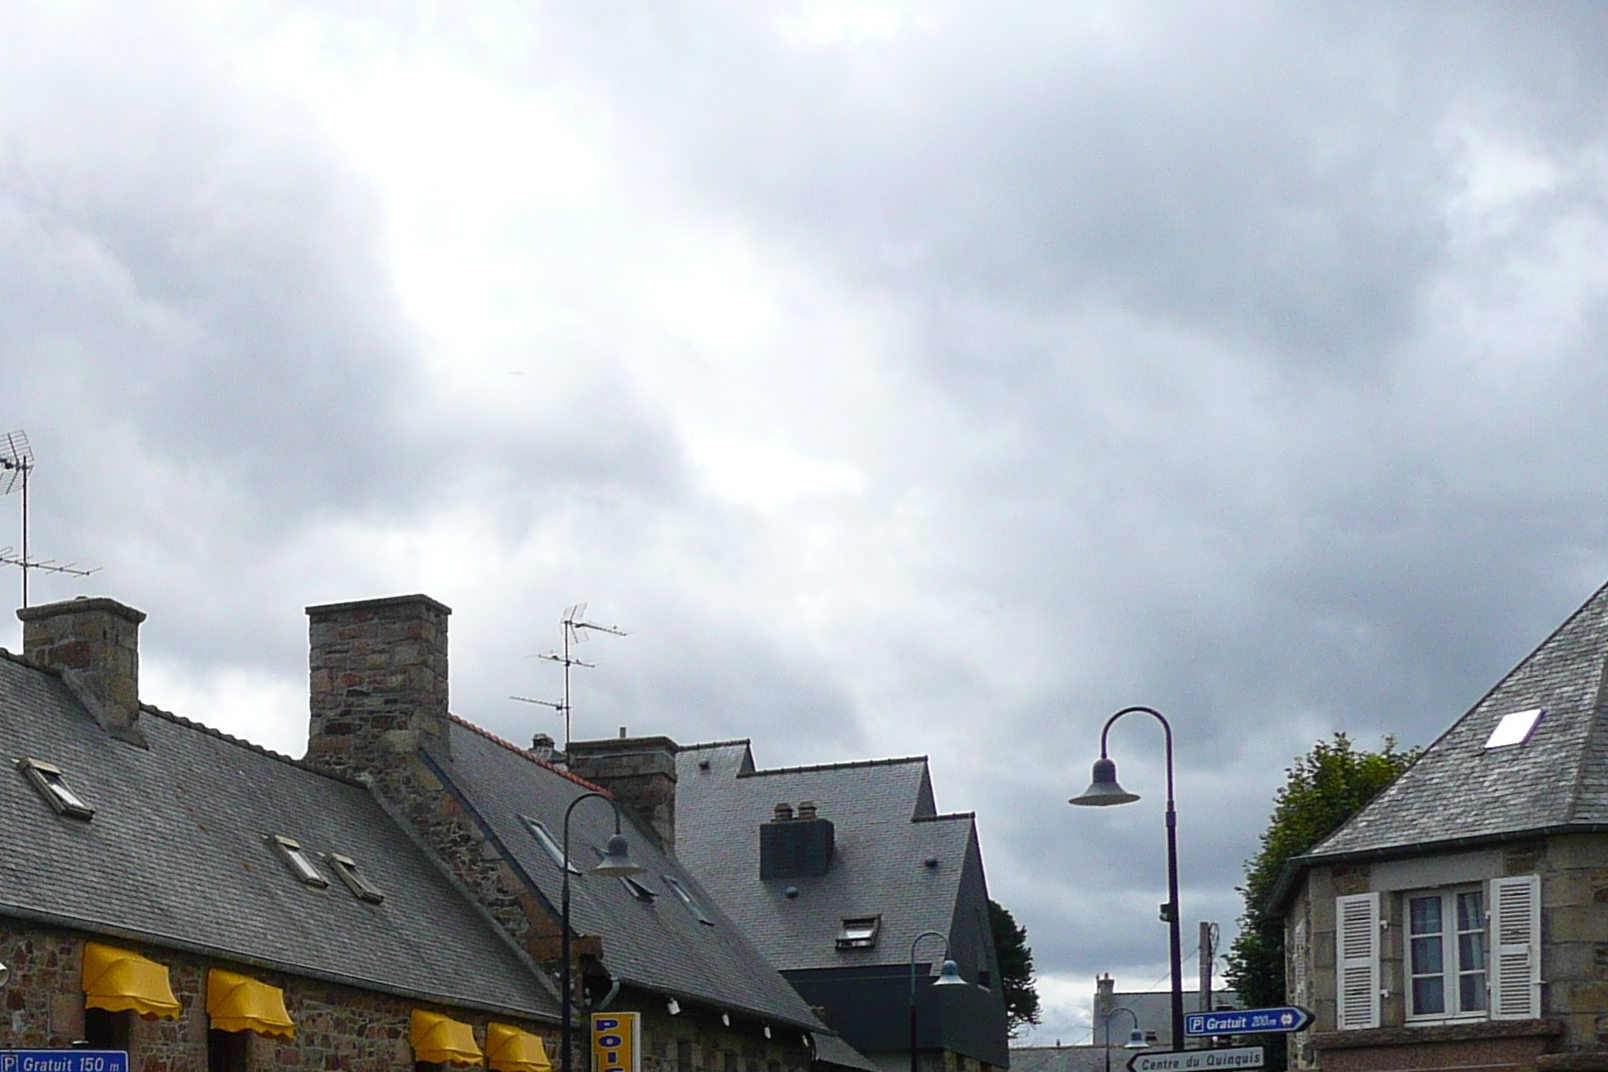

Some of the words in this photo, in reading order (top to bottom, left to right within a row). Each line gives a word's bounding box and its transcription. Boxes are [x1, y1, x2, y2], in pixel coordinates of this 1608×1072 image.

[1207, 1017, 1247, 1030] Gratuit
[23, 1057, 73, 1072] Gratuit
[80, 1057, 104, 1072] 150
[109, 1062, 120, 1072] m
[1142, 1058, 1179, 1070] Centre
[1186, 1056, 1199, 1067] du
[1206, 1053, 1260, 1067] Quinquis
